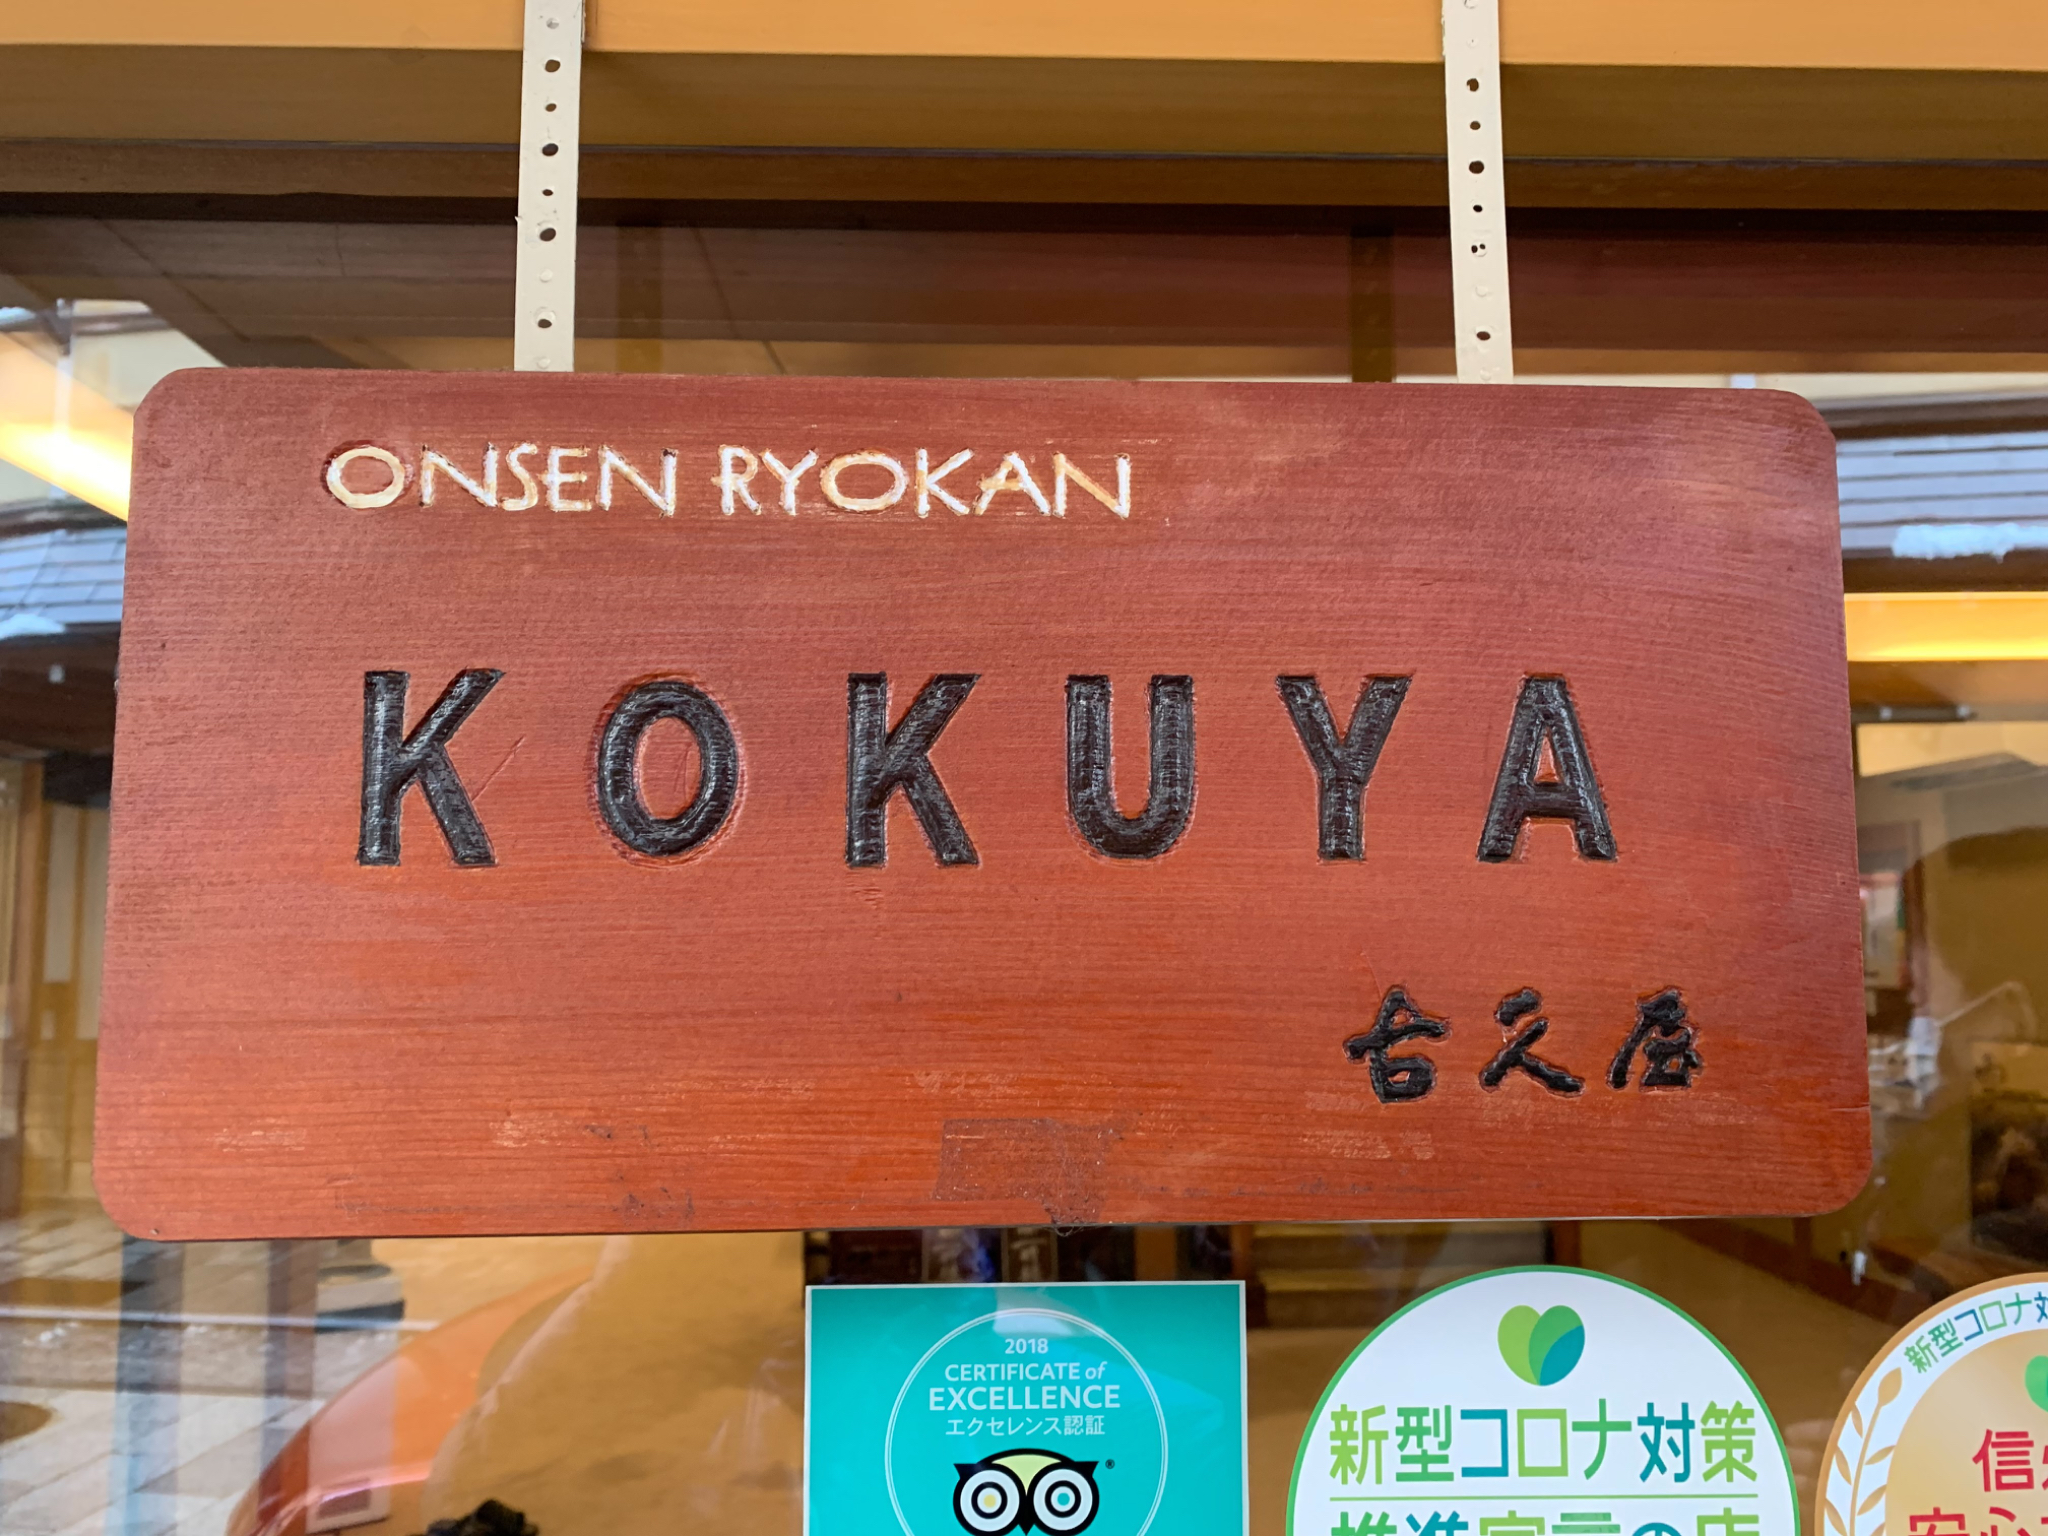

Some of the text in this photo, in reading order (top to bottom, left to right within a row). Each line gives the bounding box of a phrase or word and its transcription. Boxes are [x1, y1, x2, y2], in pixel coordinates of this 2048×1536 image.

[323, 440, 1133, 521] ONSEN RYOKAN
[356, 669, 1619, 869] KOKUYA
[1004, 1338, 1049, 1355] 2018
[944, 1361, 1106, 1382] CERTIFICATE of
[929, 1385, 1121, 1411] EXCELLENCE
[945, 1415, 1106, 1437] エクセレンス認証
[1329, 1398, 1758, 1486] 新型コロナ対策
[1972, 1428, 2048, 1493] 信
